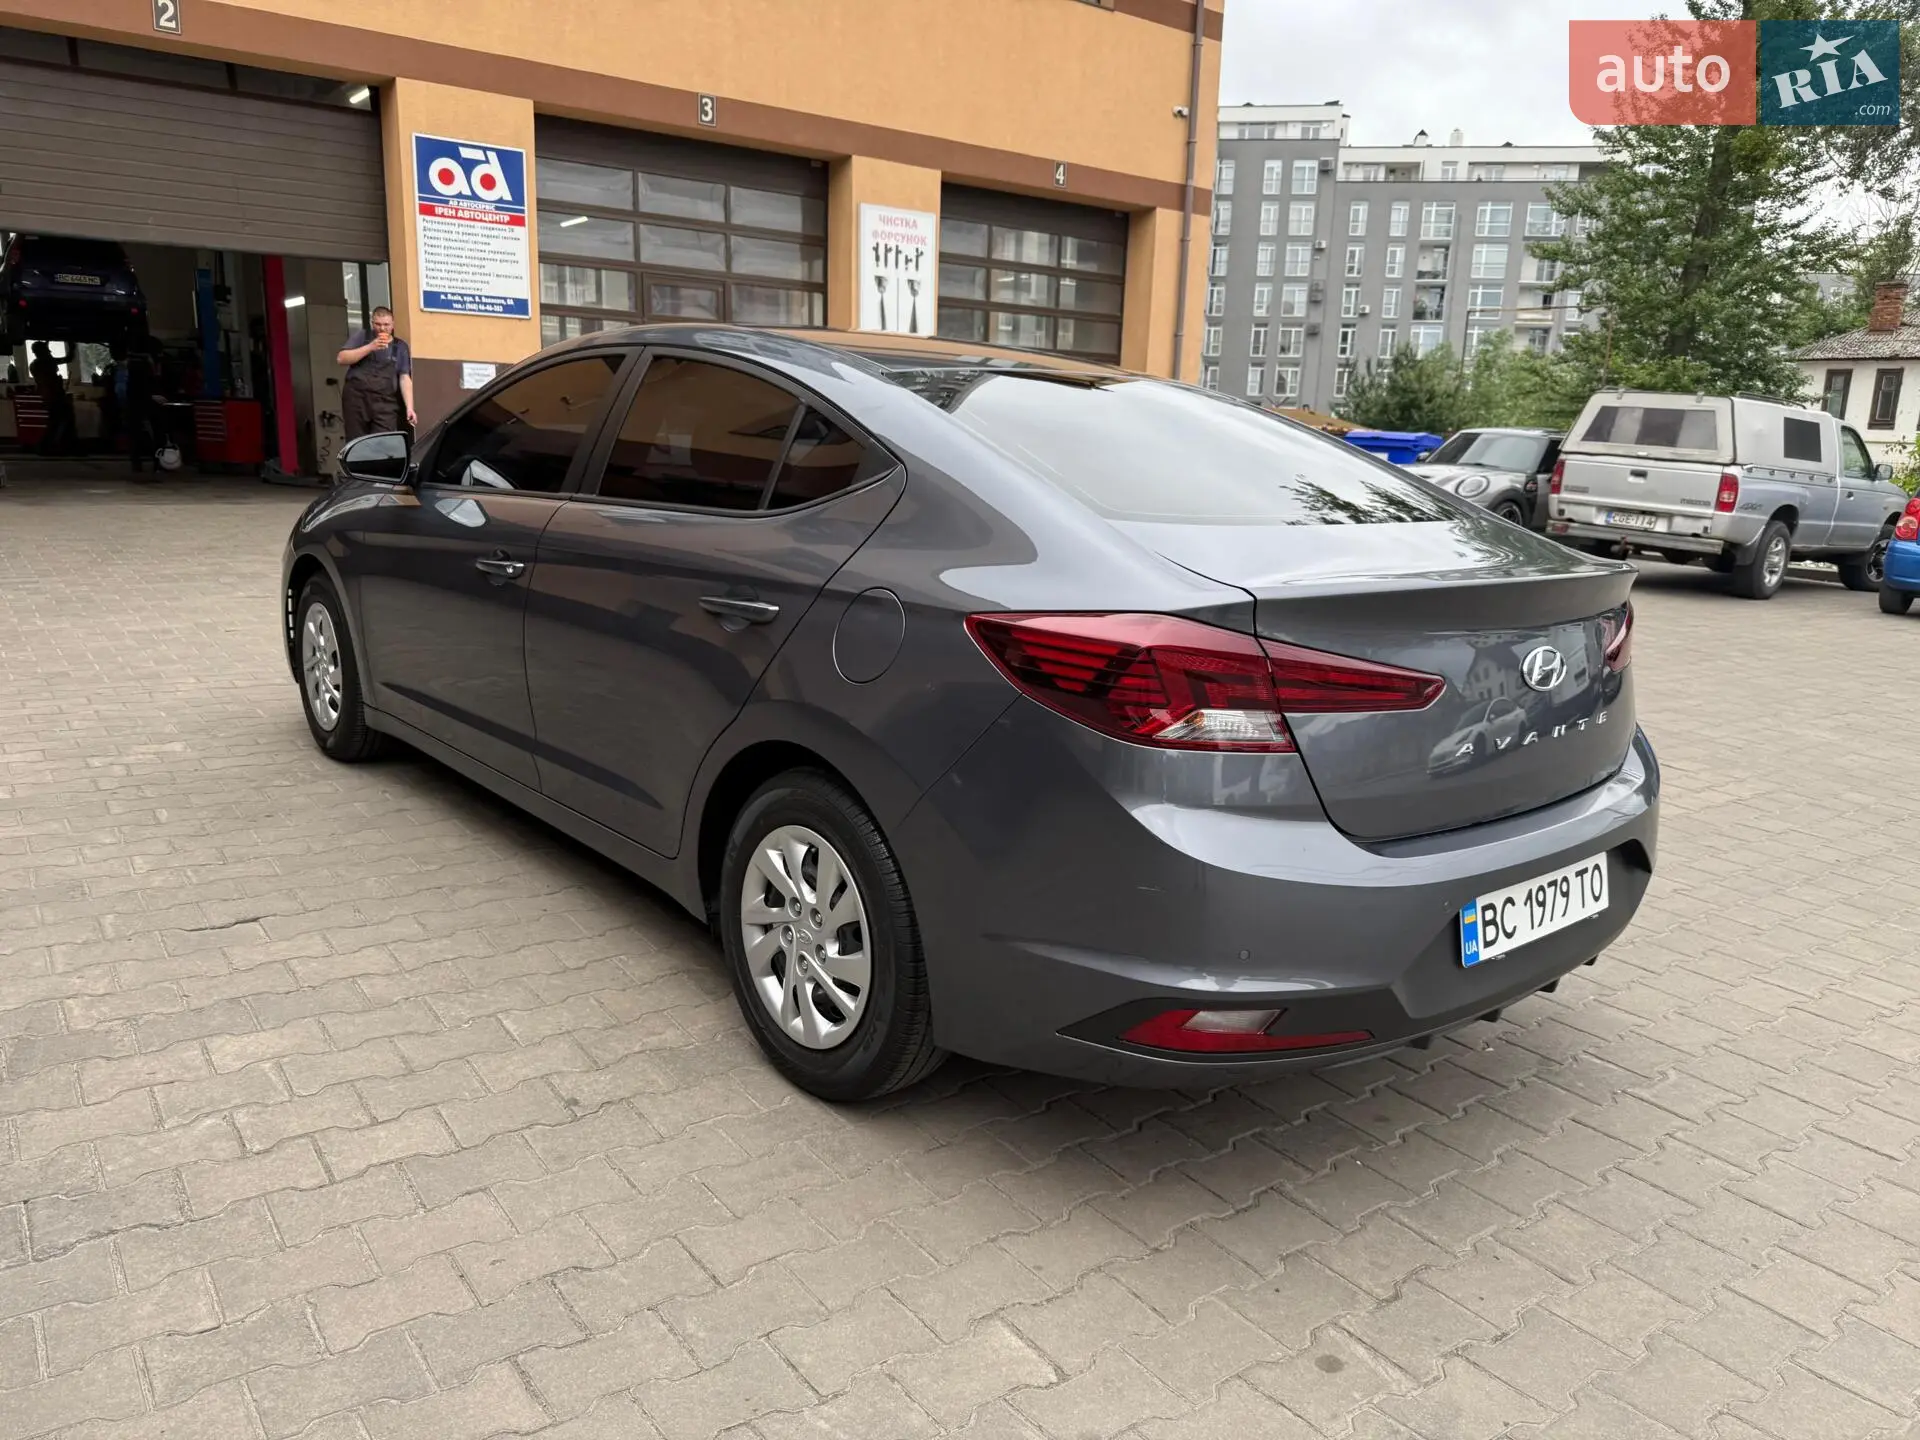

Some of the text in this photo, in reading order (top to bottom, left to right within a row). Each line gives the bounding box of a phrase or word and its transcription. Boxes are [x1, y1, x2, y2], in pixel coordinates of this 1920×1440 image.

[158, 0, 176, 28] 2
[702, 97, 713, 121] 3
[1055, 164, 1065, 185] 4
[435, 207, 510, 224] ІРЕН АВТОЦЕНТР
[879, 214, 918, 229] ЧИСТКА
[872, 230, 927, 246] ФОРСУНОК
[1455, 711, 1608, 757] AVANTE
[1481, 864, 1603, 949] BC 1979 TO
[1465, 939, 1478, 955] UA
